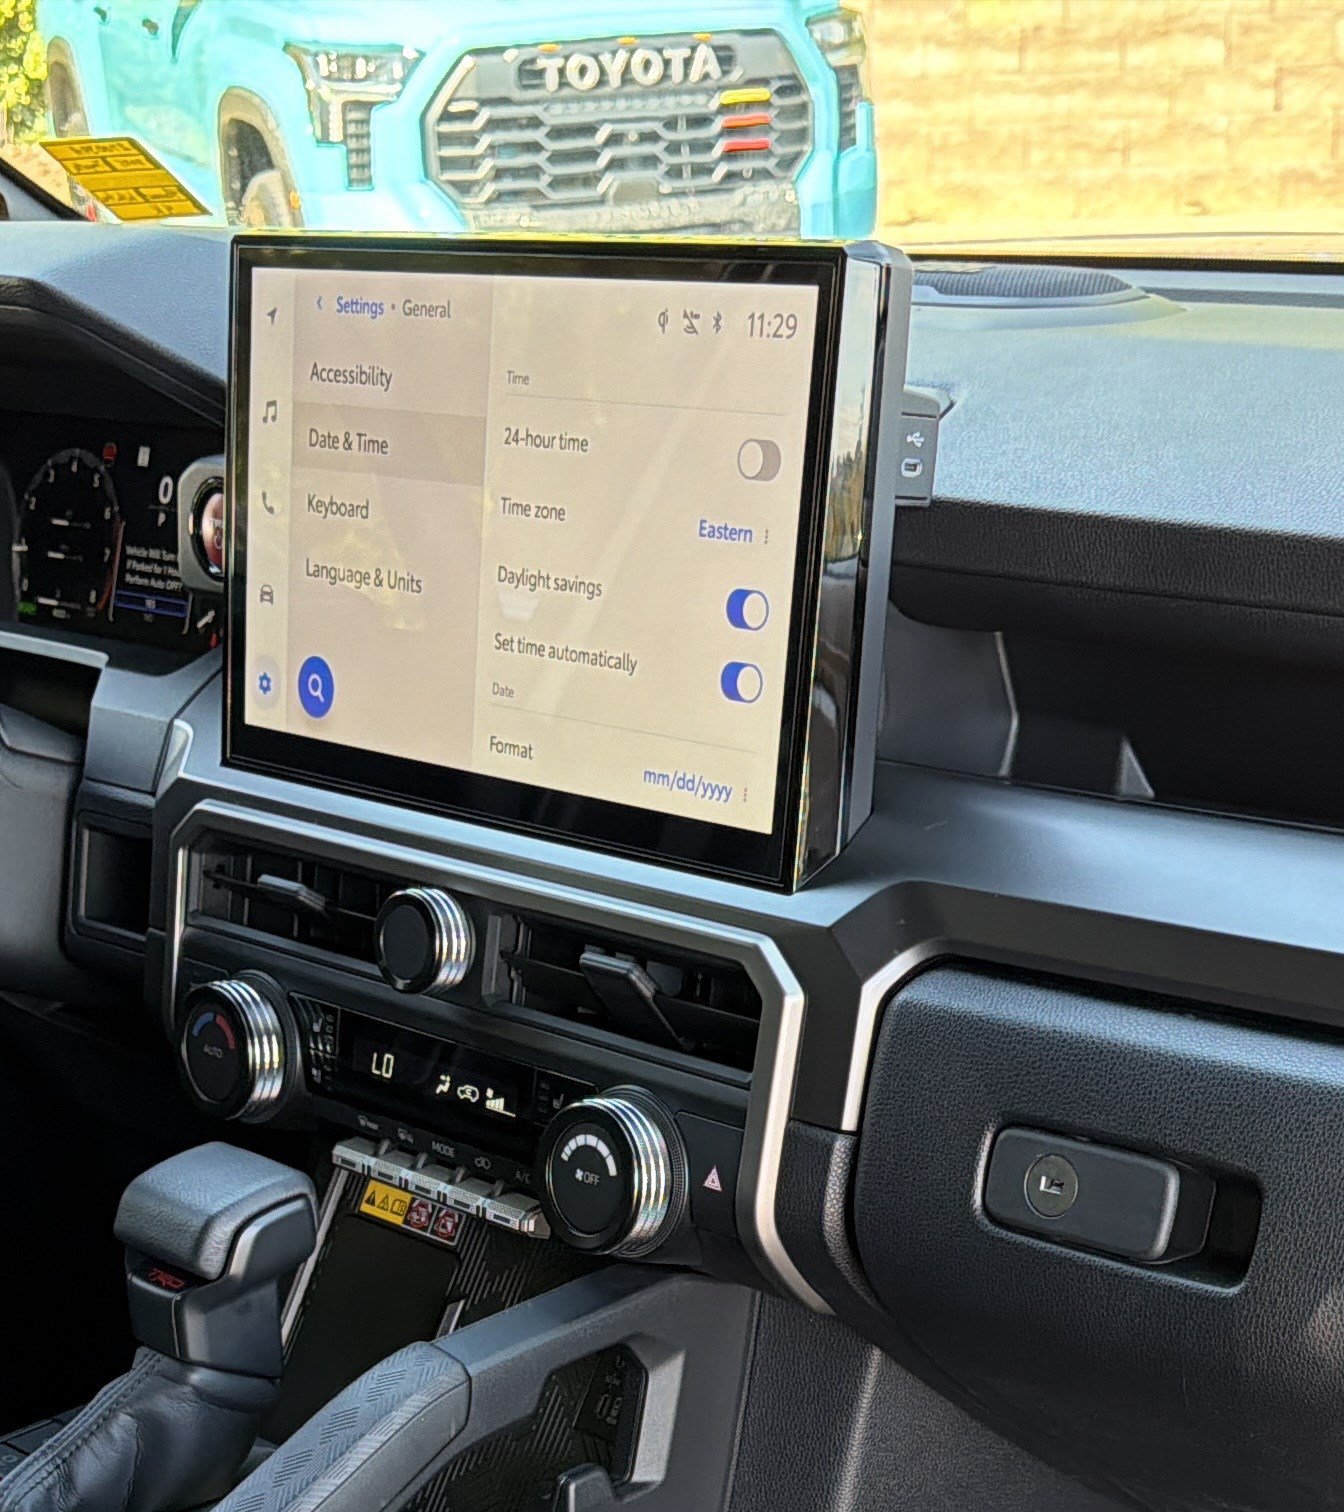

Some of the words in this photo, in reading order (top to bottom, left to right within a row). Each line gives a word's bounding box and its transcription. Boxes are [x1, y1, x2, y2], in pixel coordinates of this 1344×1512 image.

[538, 44, 723, 92] TOYOTA
[336, 296, 384, 319] Settings
[402, 299, 452, 319] General
[747, 311, 798, 339] 11:29
[309, 362, 393, 392] Accessibility
[507, 370, 530, 385] Time
[309, 428, 340, 450] Date
[343, 431, 353, 452] &
[356, 432, 389, 455] Time
[504, 426, 557, 450] 24-hour
[559, 432, 589, 452] time
[307, 493, 369, 519] Keyboard
[500, 496, 532, 518] Time
[534, 504, 567, 521] zone
[698, 518, 753, 544] Eastern
[306, 558, 371, 589] Language
[373, 568, 383, 588] &
[387, 569, 422, 593] Units
[497, 565, 551, 592] Daylight
[553, 575, 602, 600] savings
[494, 632, 515, 653] Set
[517, 636, 546, 658] time
[548, 644, 638, 676] automatically
[492, 682, 515, 699] Date
[489, 735, 534, 760] Format
[643, 769, 732, 803] mm/dd/yyyy
[371, 1051, 395, 1080] LO
[431, 1140, 456, 1159] MODE
[583, 1170, 600, 1186] OFF
